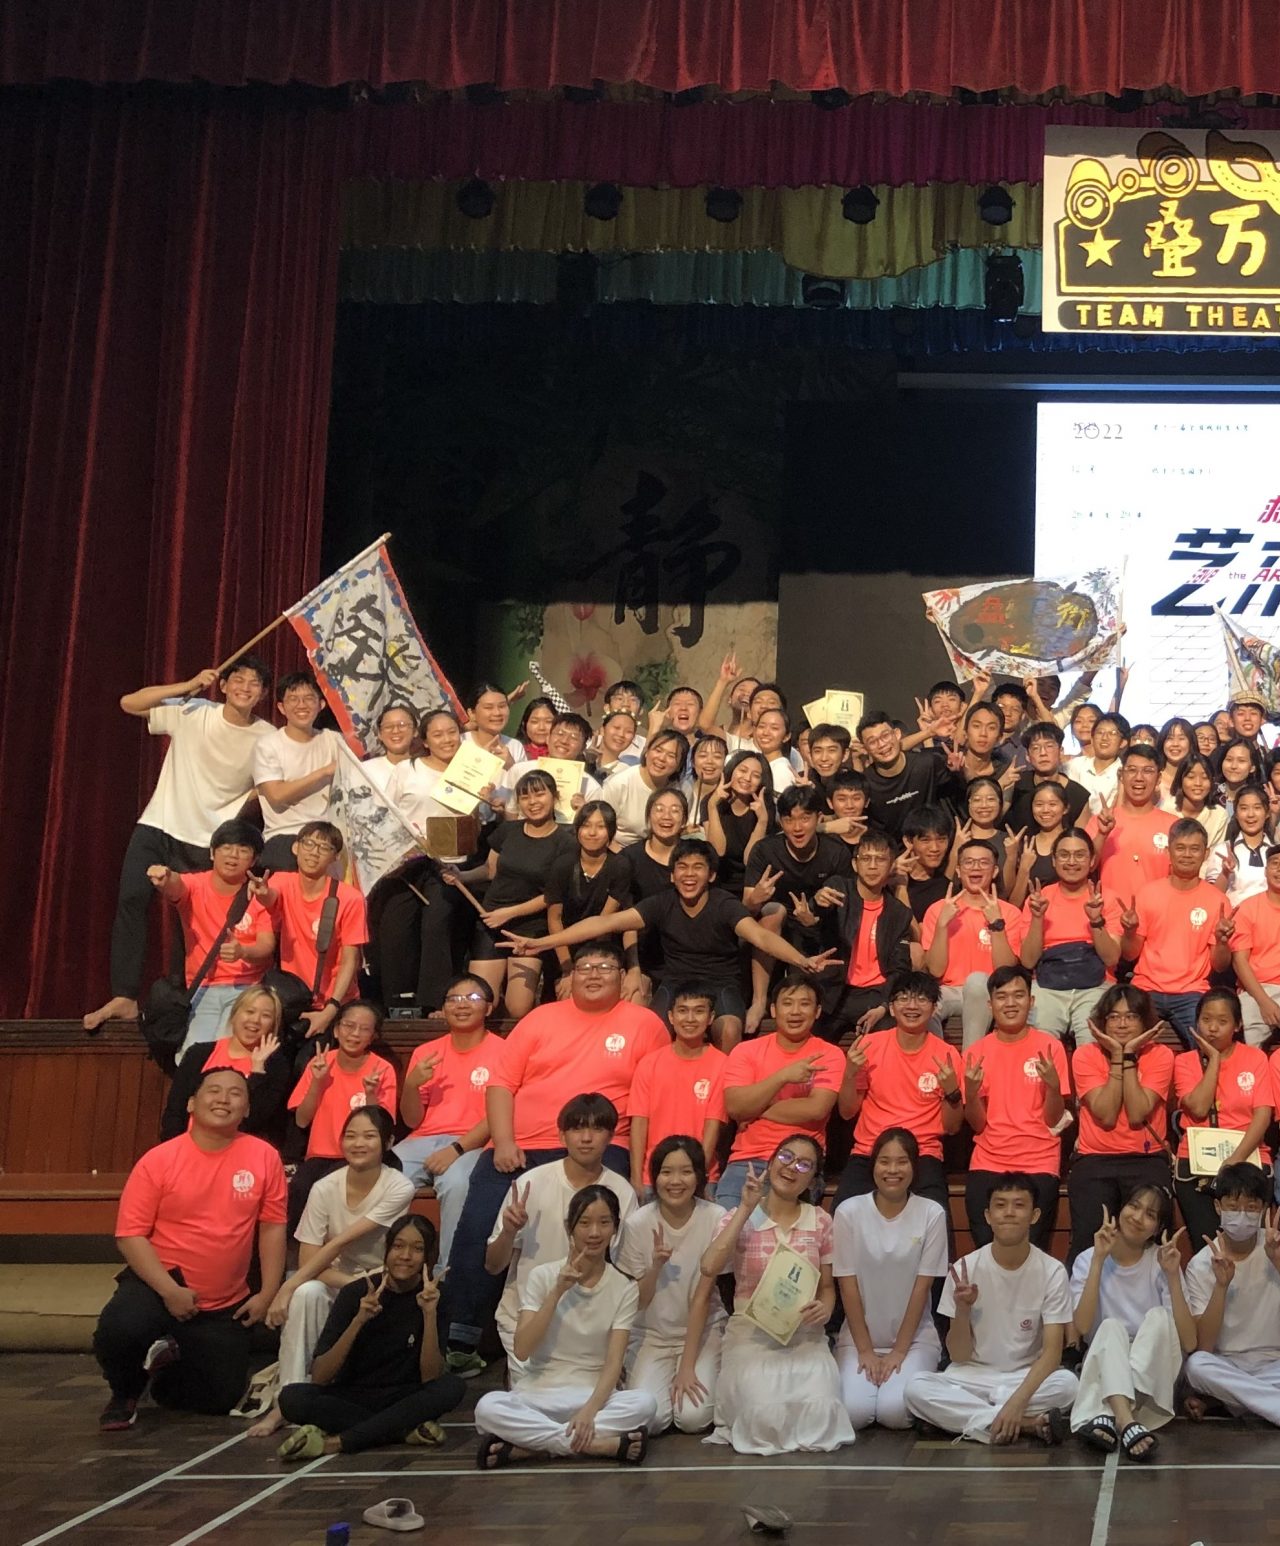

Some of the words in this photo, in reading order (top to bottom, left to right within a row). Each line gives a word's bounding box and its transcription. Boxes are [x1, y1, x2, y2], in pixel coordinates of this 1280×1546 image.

[1076, 304, 1164, 328] TEAM
[1229, 572, 1246, 580] the
[1093, 1417, 1114, 1429] NIK
